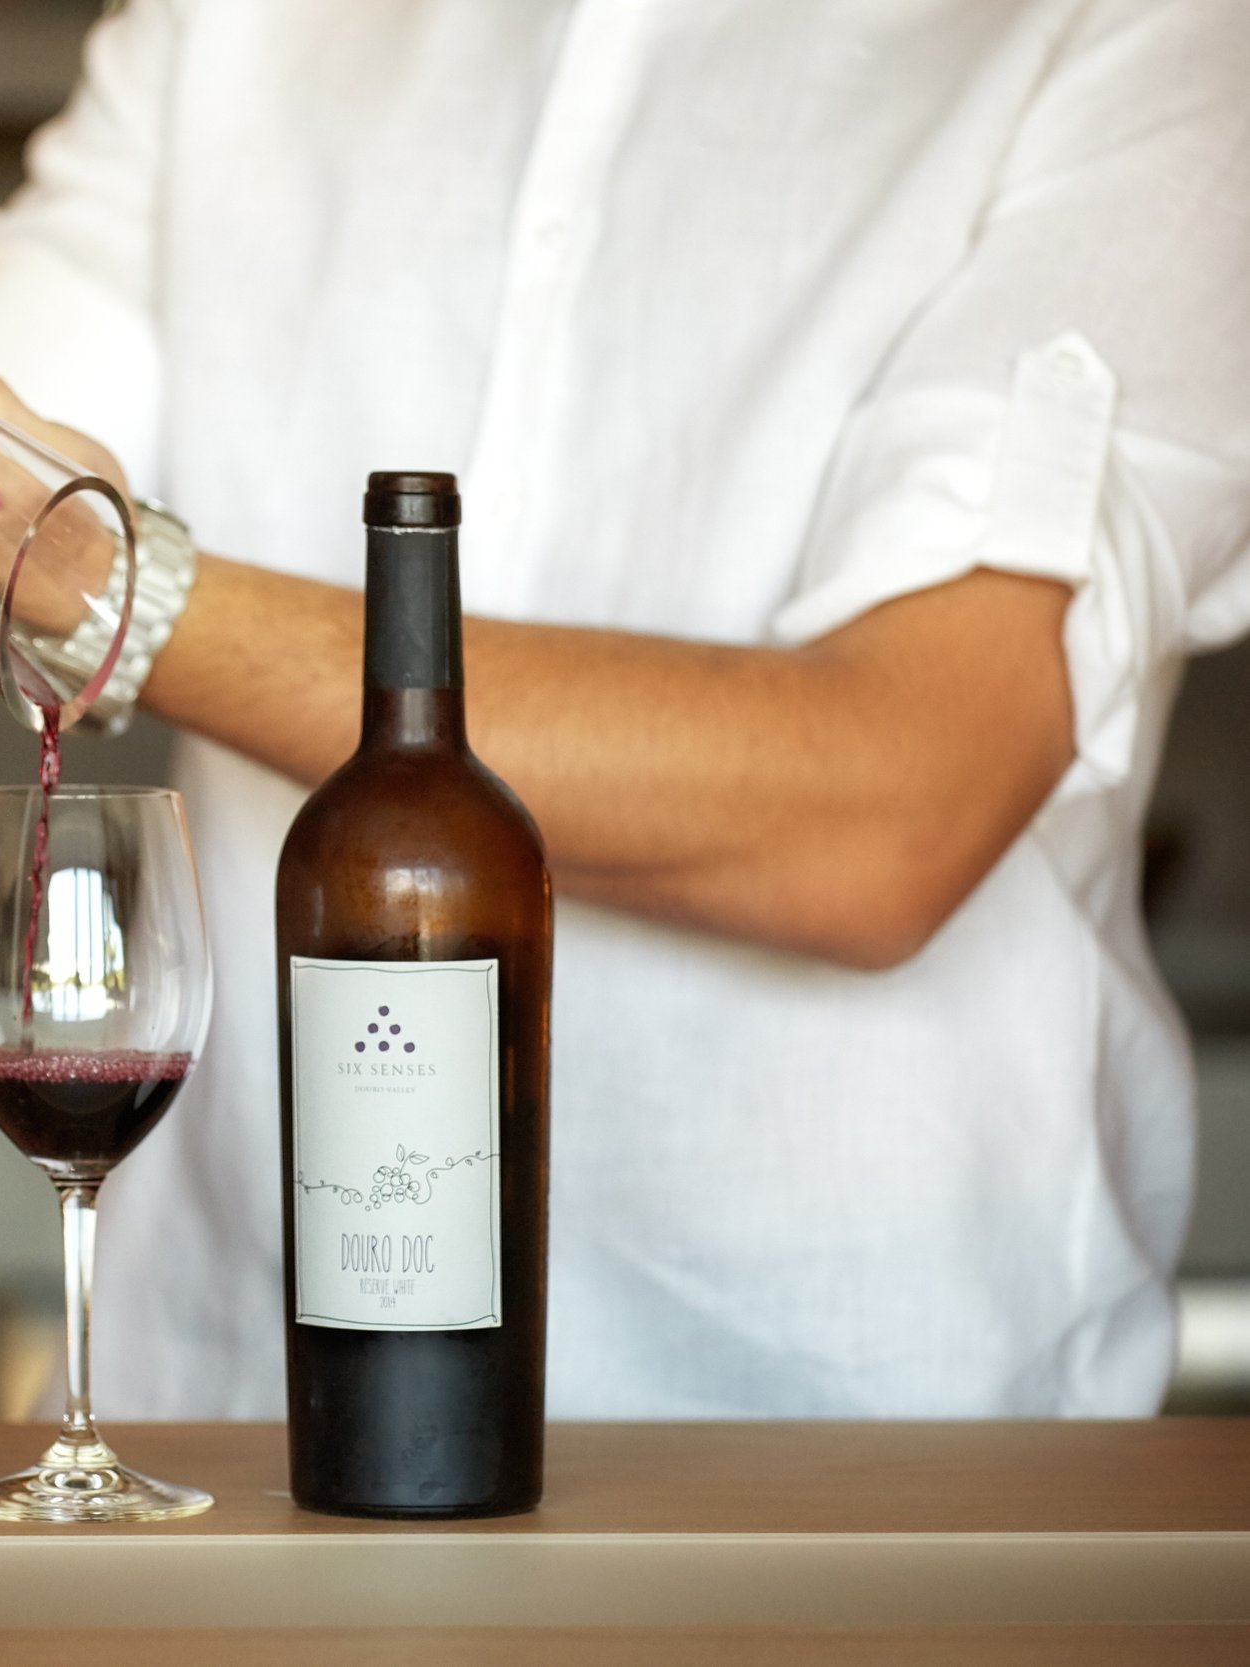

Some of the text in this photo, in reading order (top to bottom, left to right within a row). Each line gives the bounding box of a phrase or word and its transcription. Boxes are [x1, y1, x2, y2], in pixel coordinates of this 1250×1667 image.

[337, 1062, 436, 1077] SIX SENSES
[341, 1233, 435, 1273] DOURO DOC
